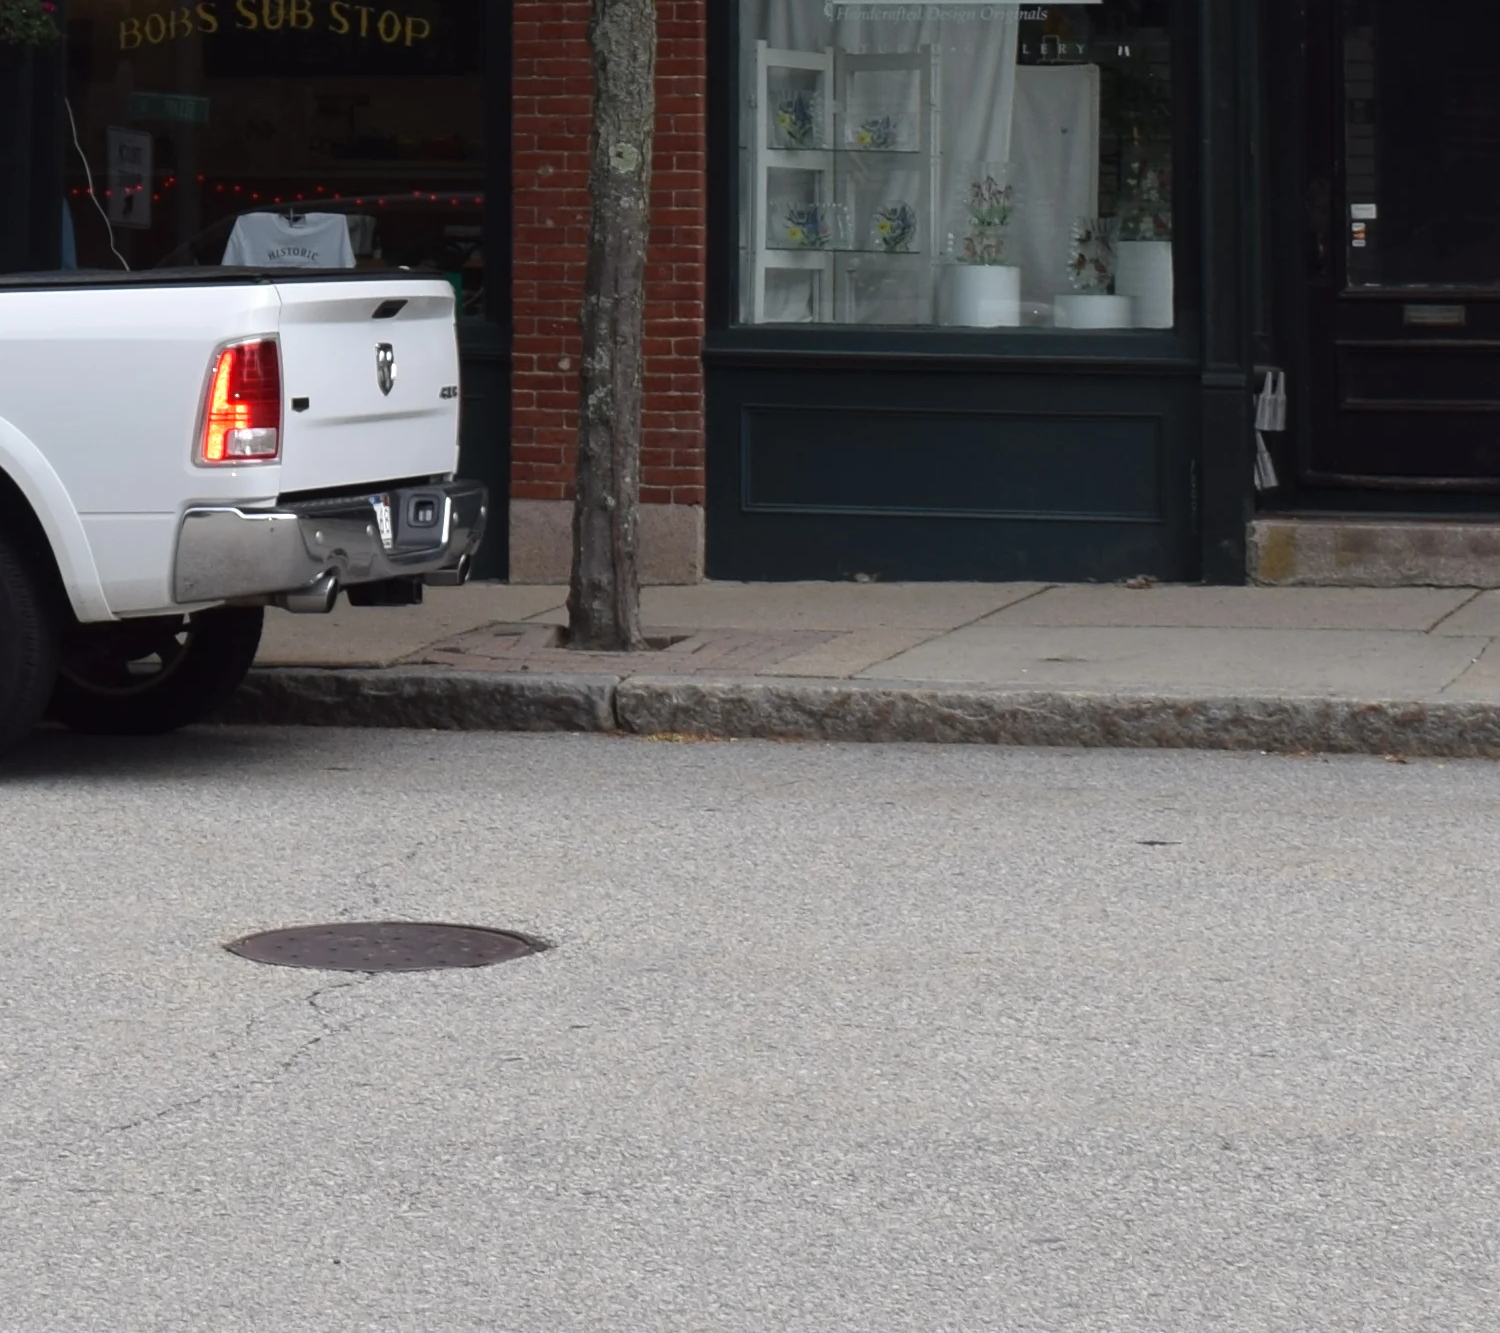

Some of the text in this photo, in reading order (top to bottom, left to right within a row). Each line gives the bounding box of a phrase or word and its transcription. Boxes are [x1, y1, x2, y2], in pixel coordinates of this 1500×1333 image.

[328, 0, 432, 47] STOP
[836, 5, 1048, 24] Handcrafted Design Originals
[267, 246, 320, 261] HISTORIC
